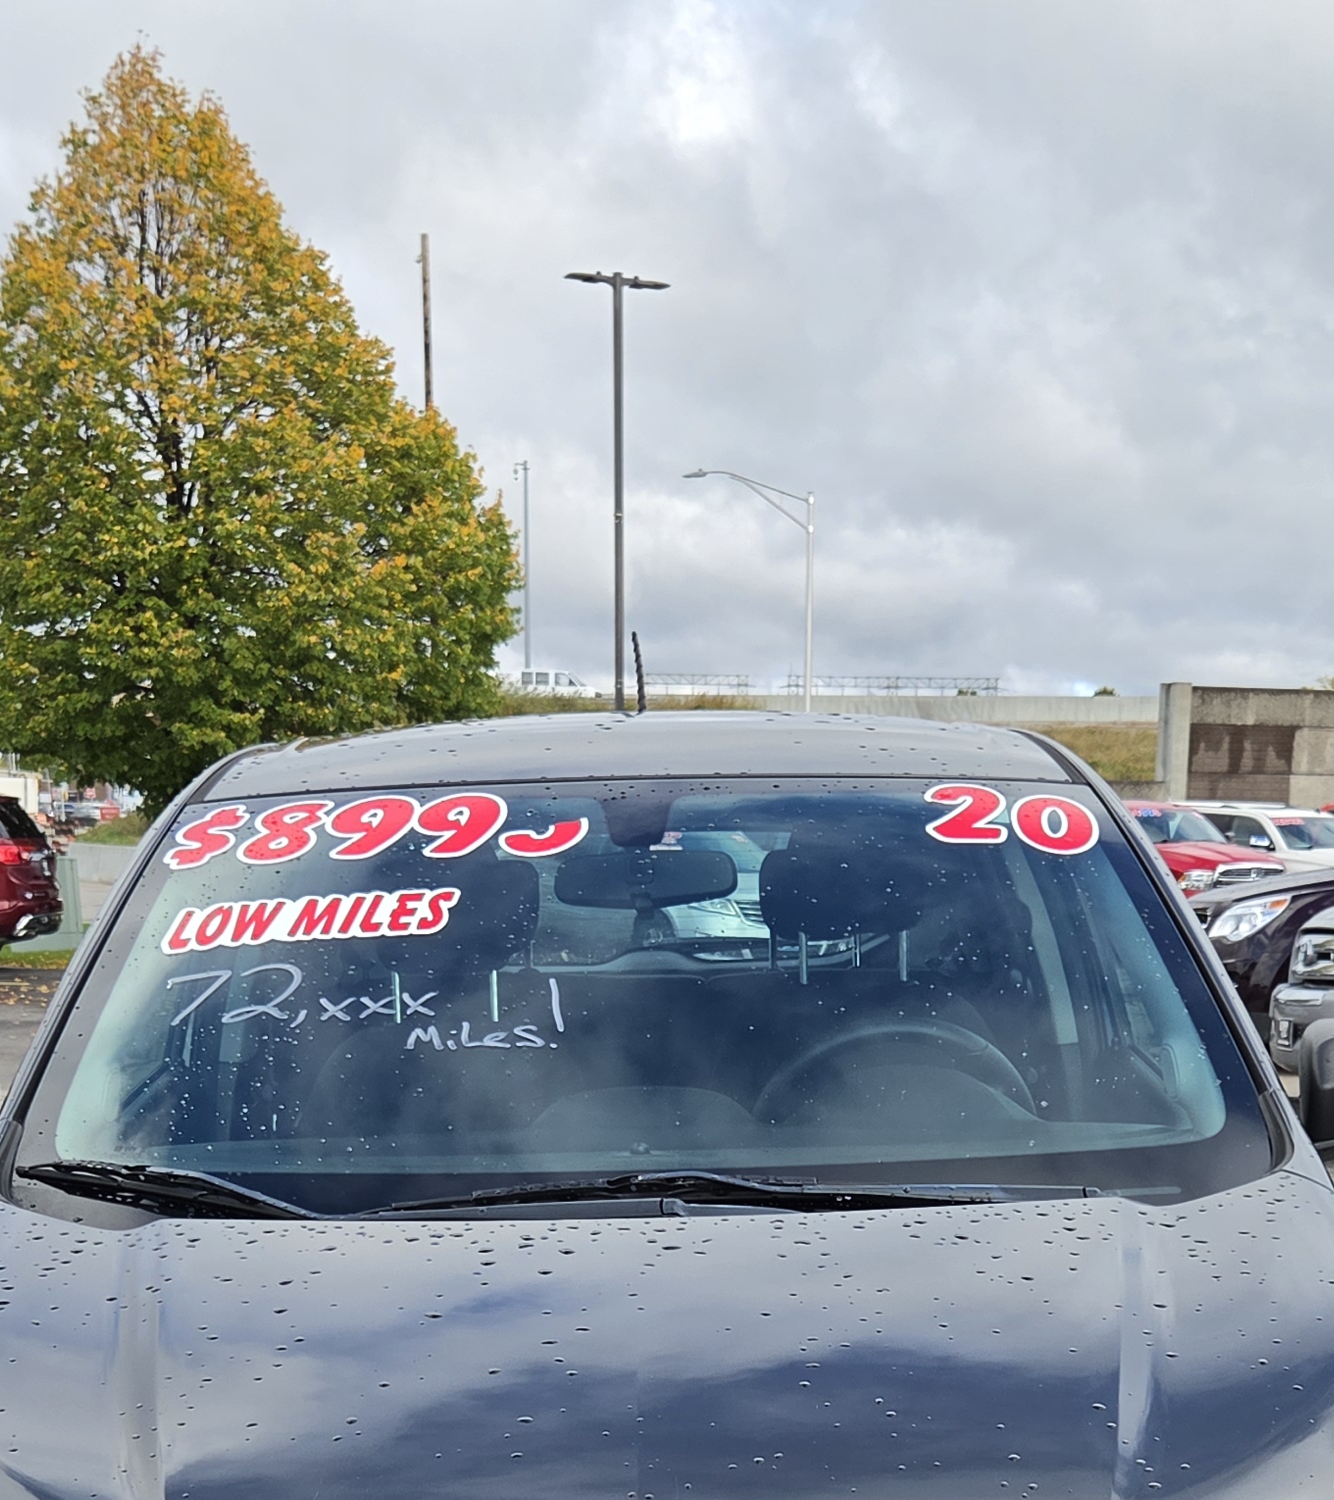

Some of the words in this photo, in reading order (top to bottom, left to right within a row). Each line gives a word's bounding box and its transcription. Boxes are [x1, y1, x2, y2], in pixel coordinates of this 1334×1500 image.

[923, 784, 1100, 855] 20
[168, 900, 285, 951] LOW
[287, 891, 458, 937] MILES
